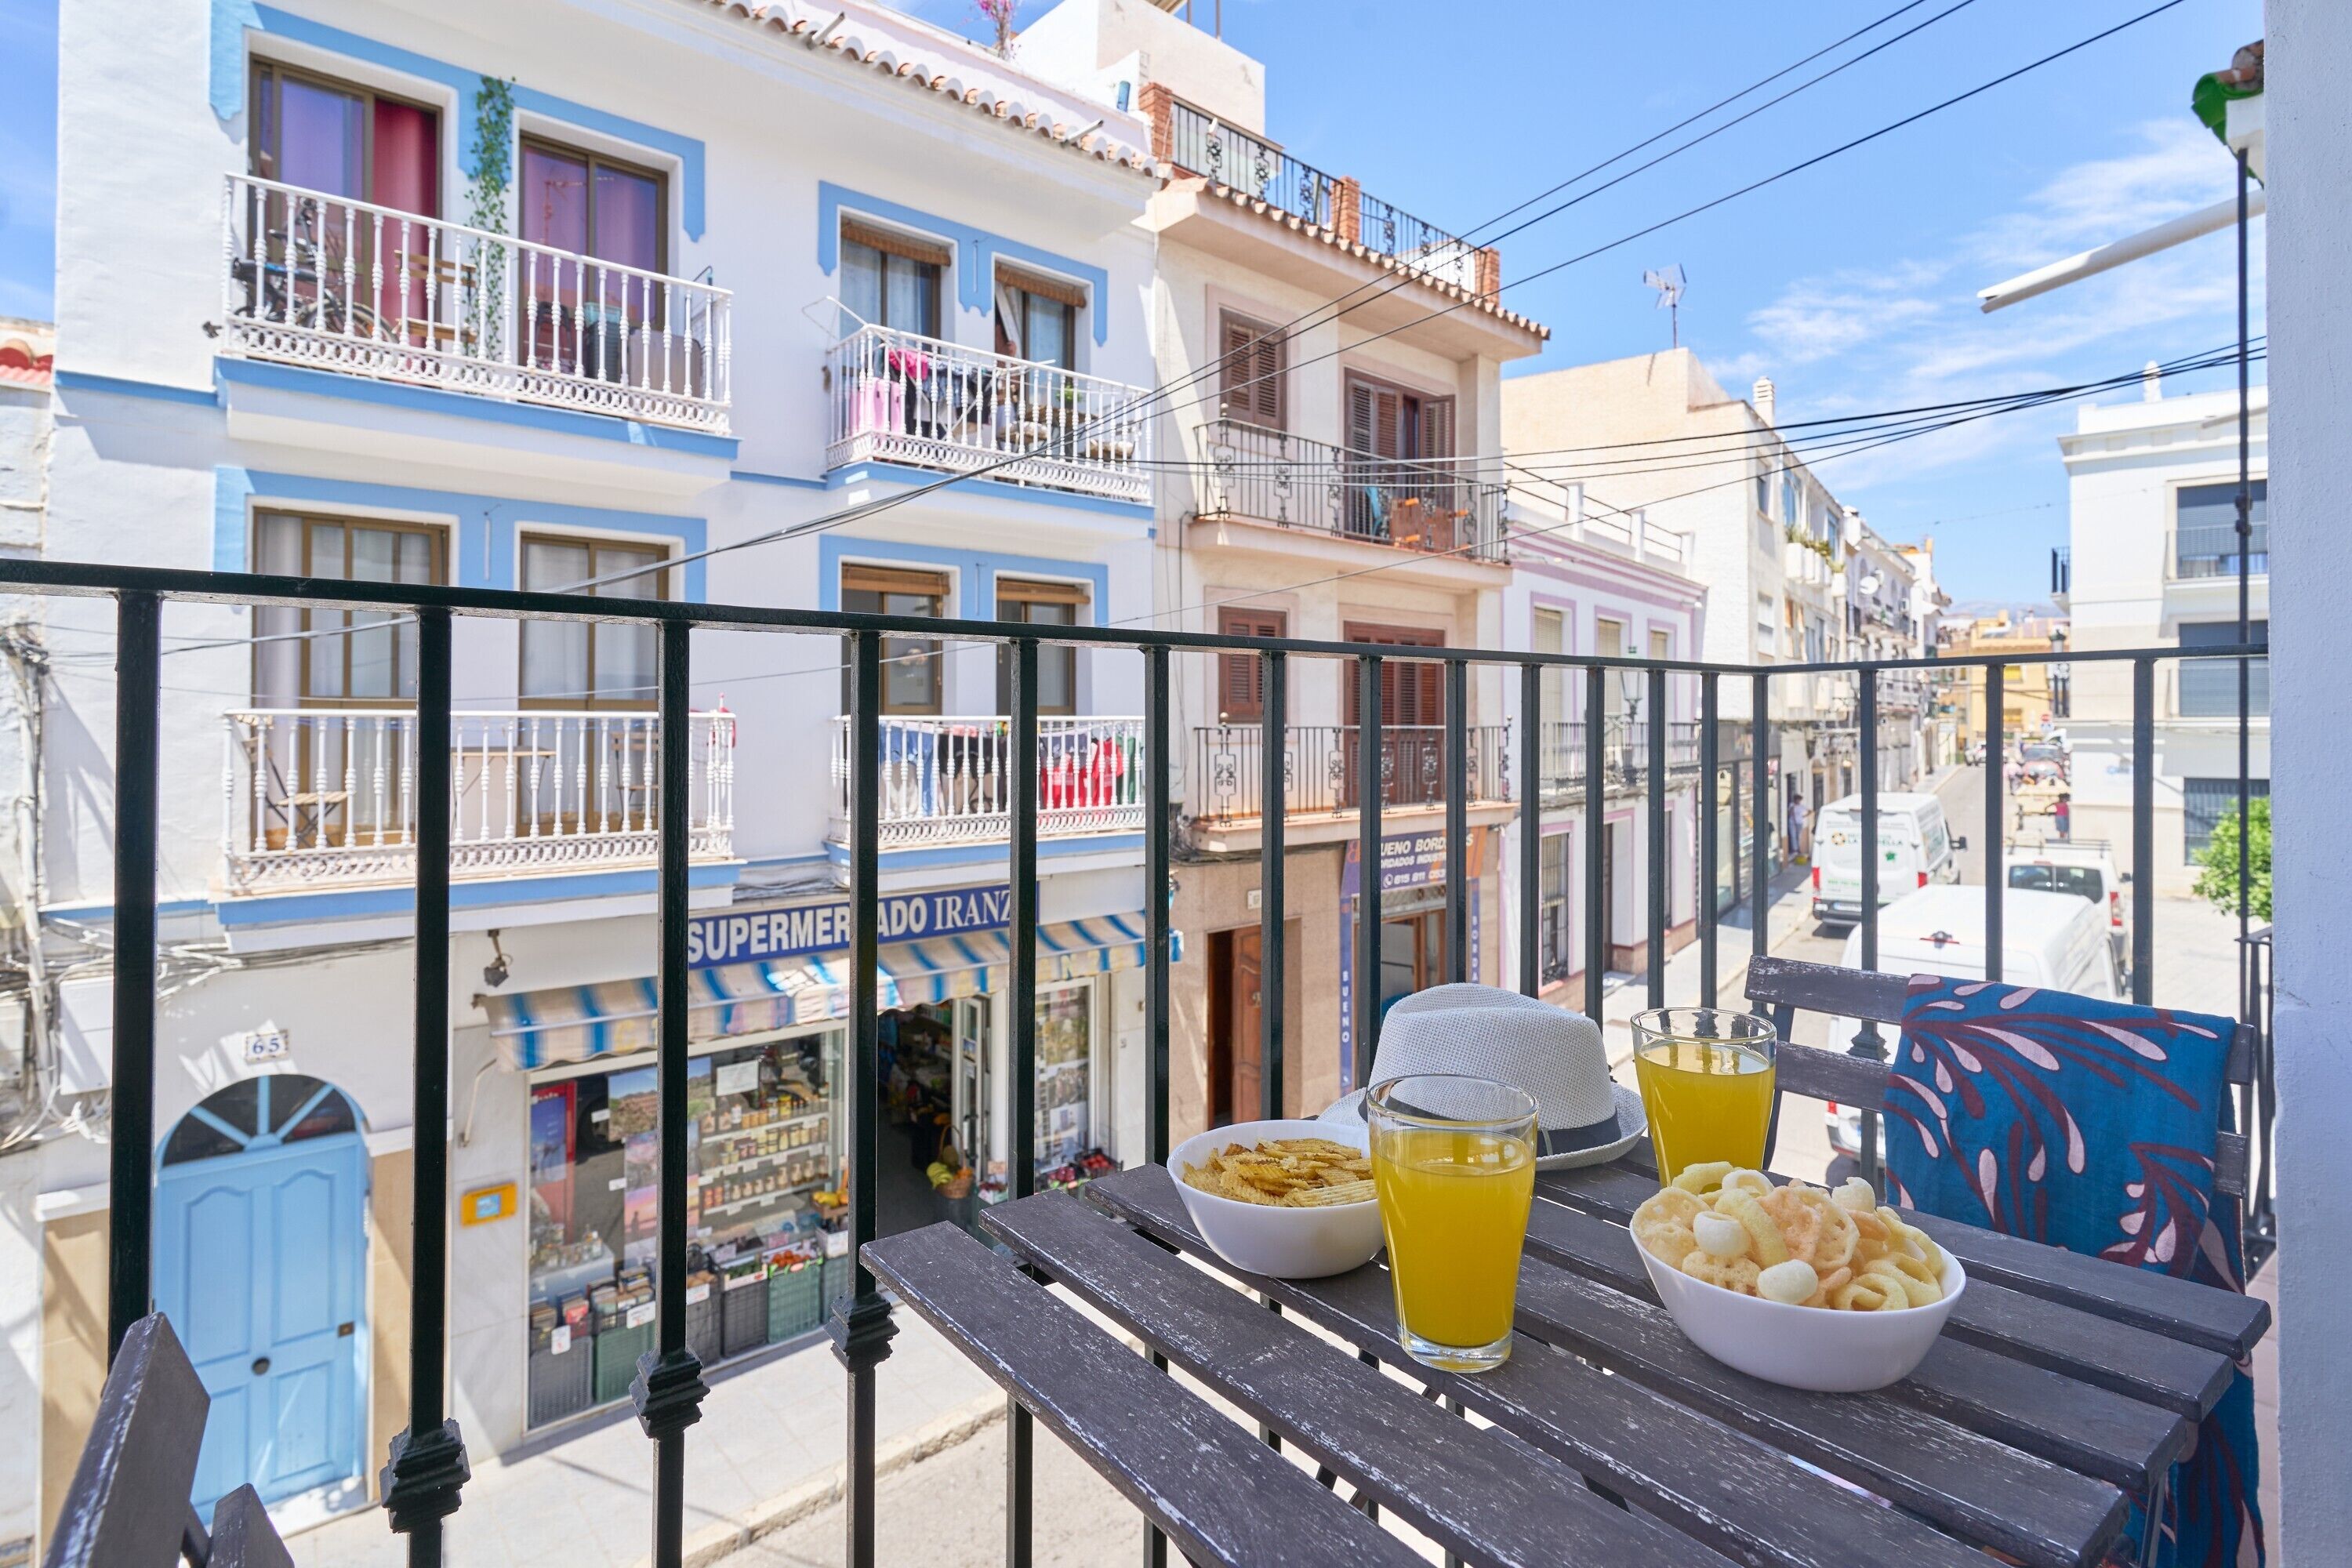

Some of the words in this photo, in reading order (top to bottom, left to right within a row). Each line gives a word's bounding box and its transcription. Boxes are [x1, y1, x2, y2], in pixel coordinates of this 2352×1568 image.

[1381, 840, 1411, 857] UENO
[1414, 833, 1474, 853] BORDS
[688, 896, 928, 964] SUPERMERADO
[934, 889, 1011, 931] IRANZ
[1471, 915, 1479, 982] BORDA
[1341, 970, 1350, 1044] BUENO
[252, 1038, 280, 1054] 65
